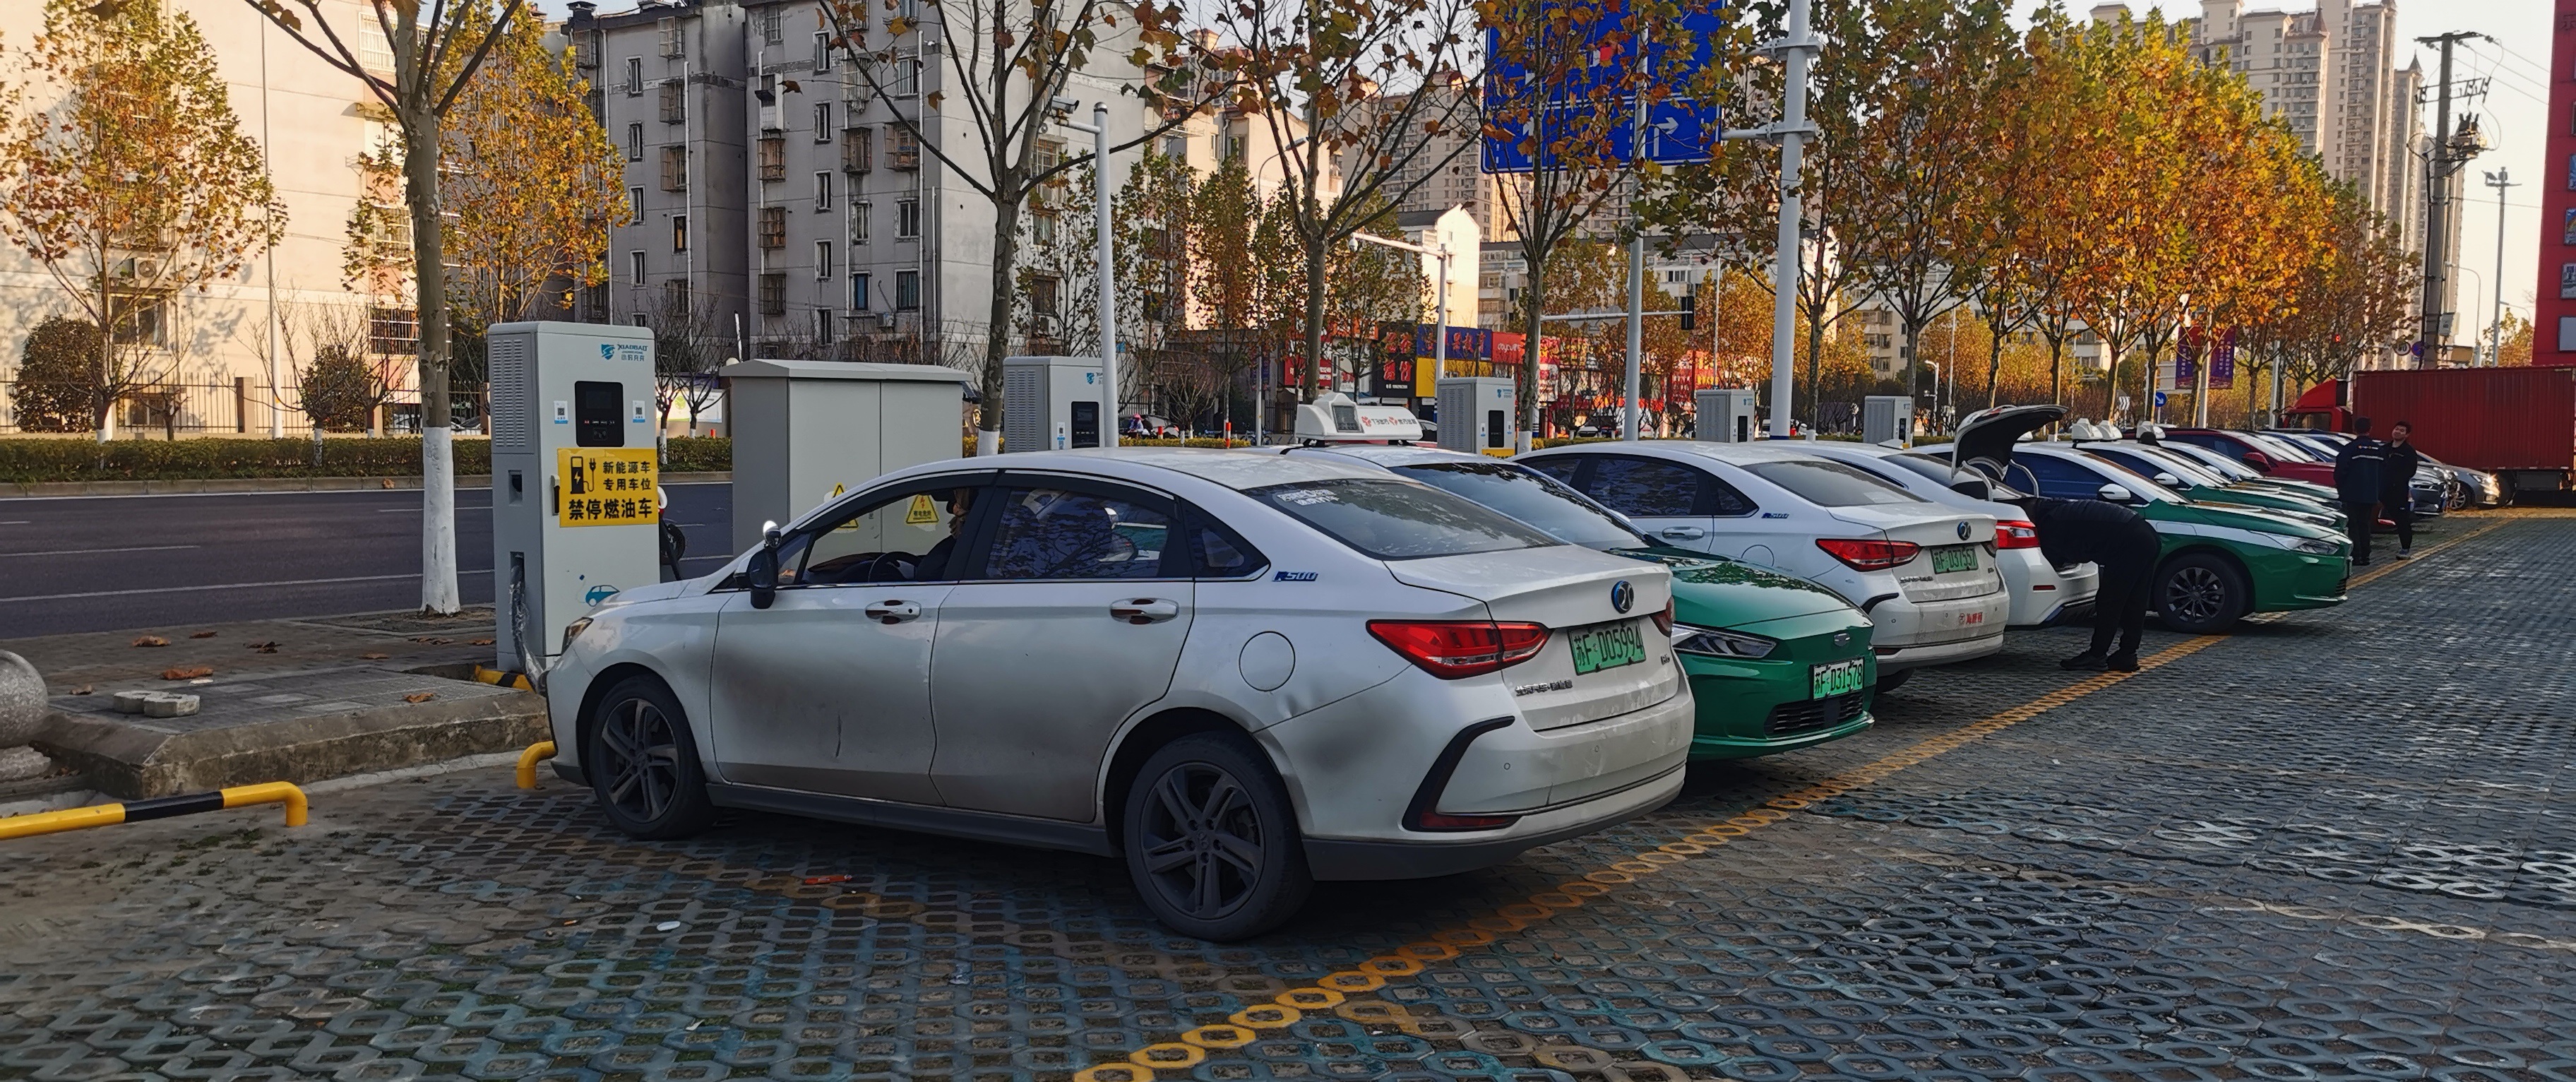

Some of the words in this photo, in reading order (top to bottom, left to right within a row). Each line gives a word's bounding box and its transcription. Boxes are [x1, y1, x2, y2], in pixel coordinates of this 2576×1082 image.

[602, 460, 651, 474] 新能源车
[602, 478, 651, 491] 专用车位
[568, 498, 652, 521] 禁停燃油车
